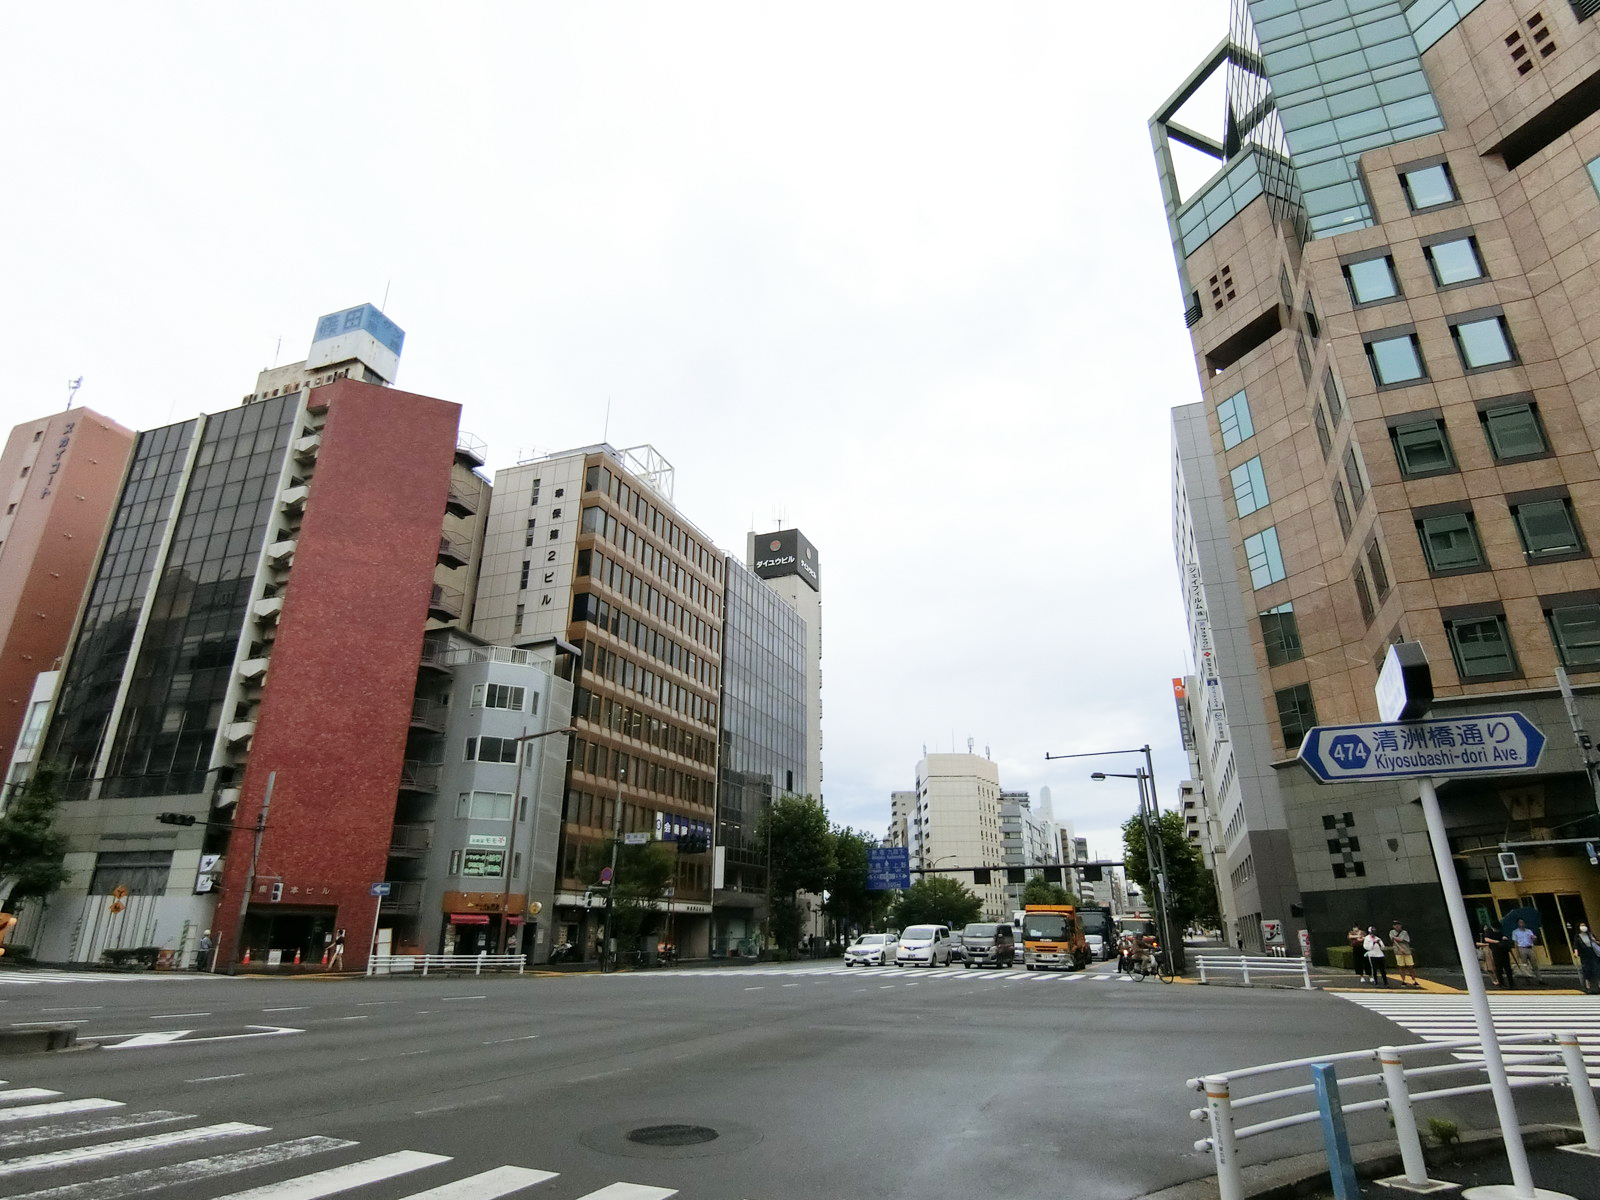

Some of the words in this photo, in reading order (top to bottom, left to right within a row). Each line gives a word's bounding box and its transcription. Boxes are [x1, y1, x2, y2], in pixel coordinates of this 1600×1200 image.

[755, 555, 796, 569] ダイユウビル
[1372, 720, 1511, 753] 清洲橋通り
[1333, 742, 1367, 762] 474
[1374, 746, 1488, 771] Kiyosubashi-dori
[1493, 746, 1523, 762] Ave.
